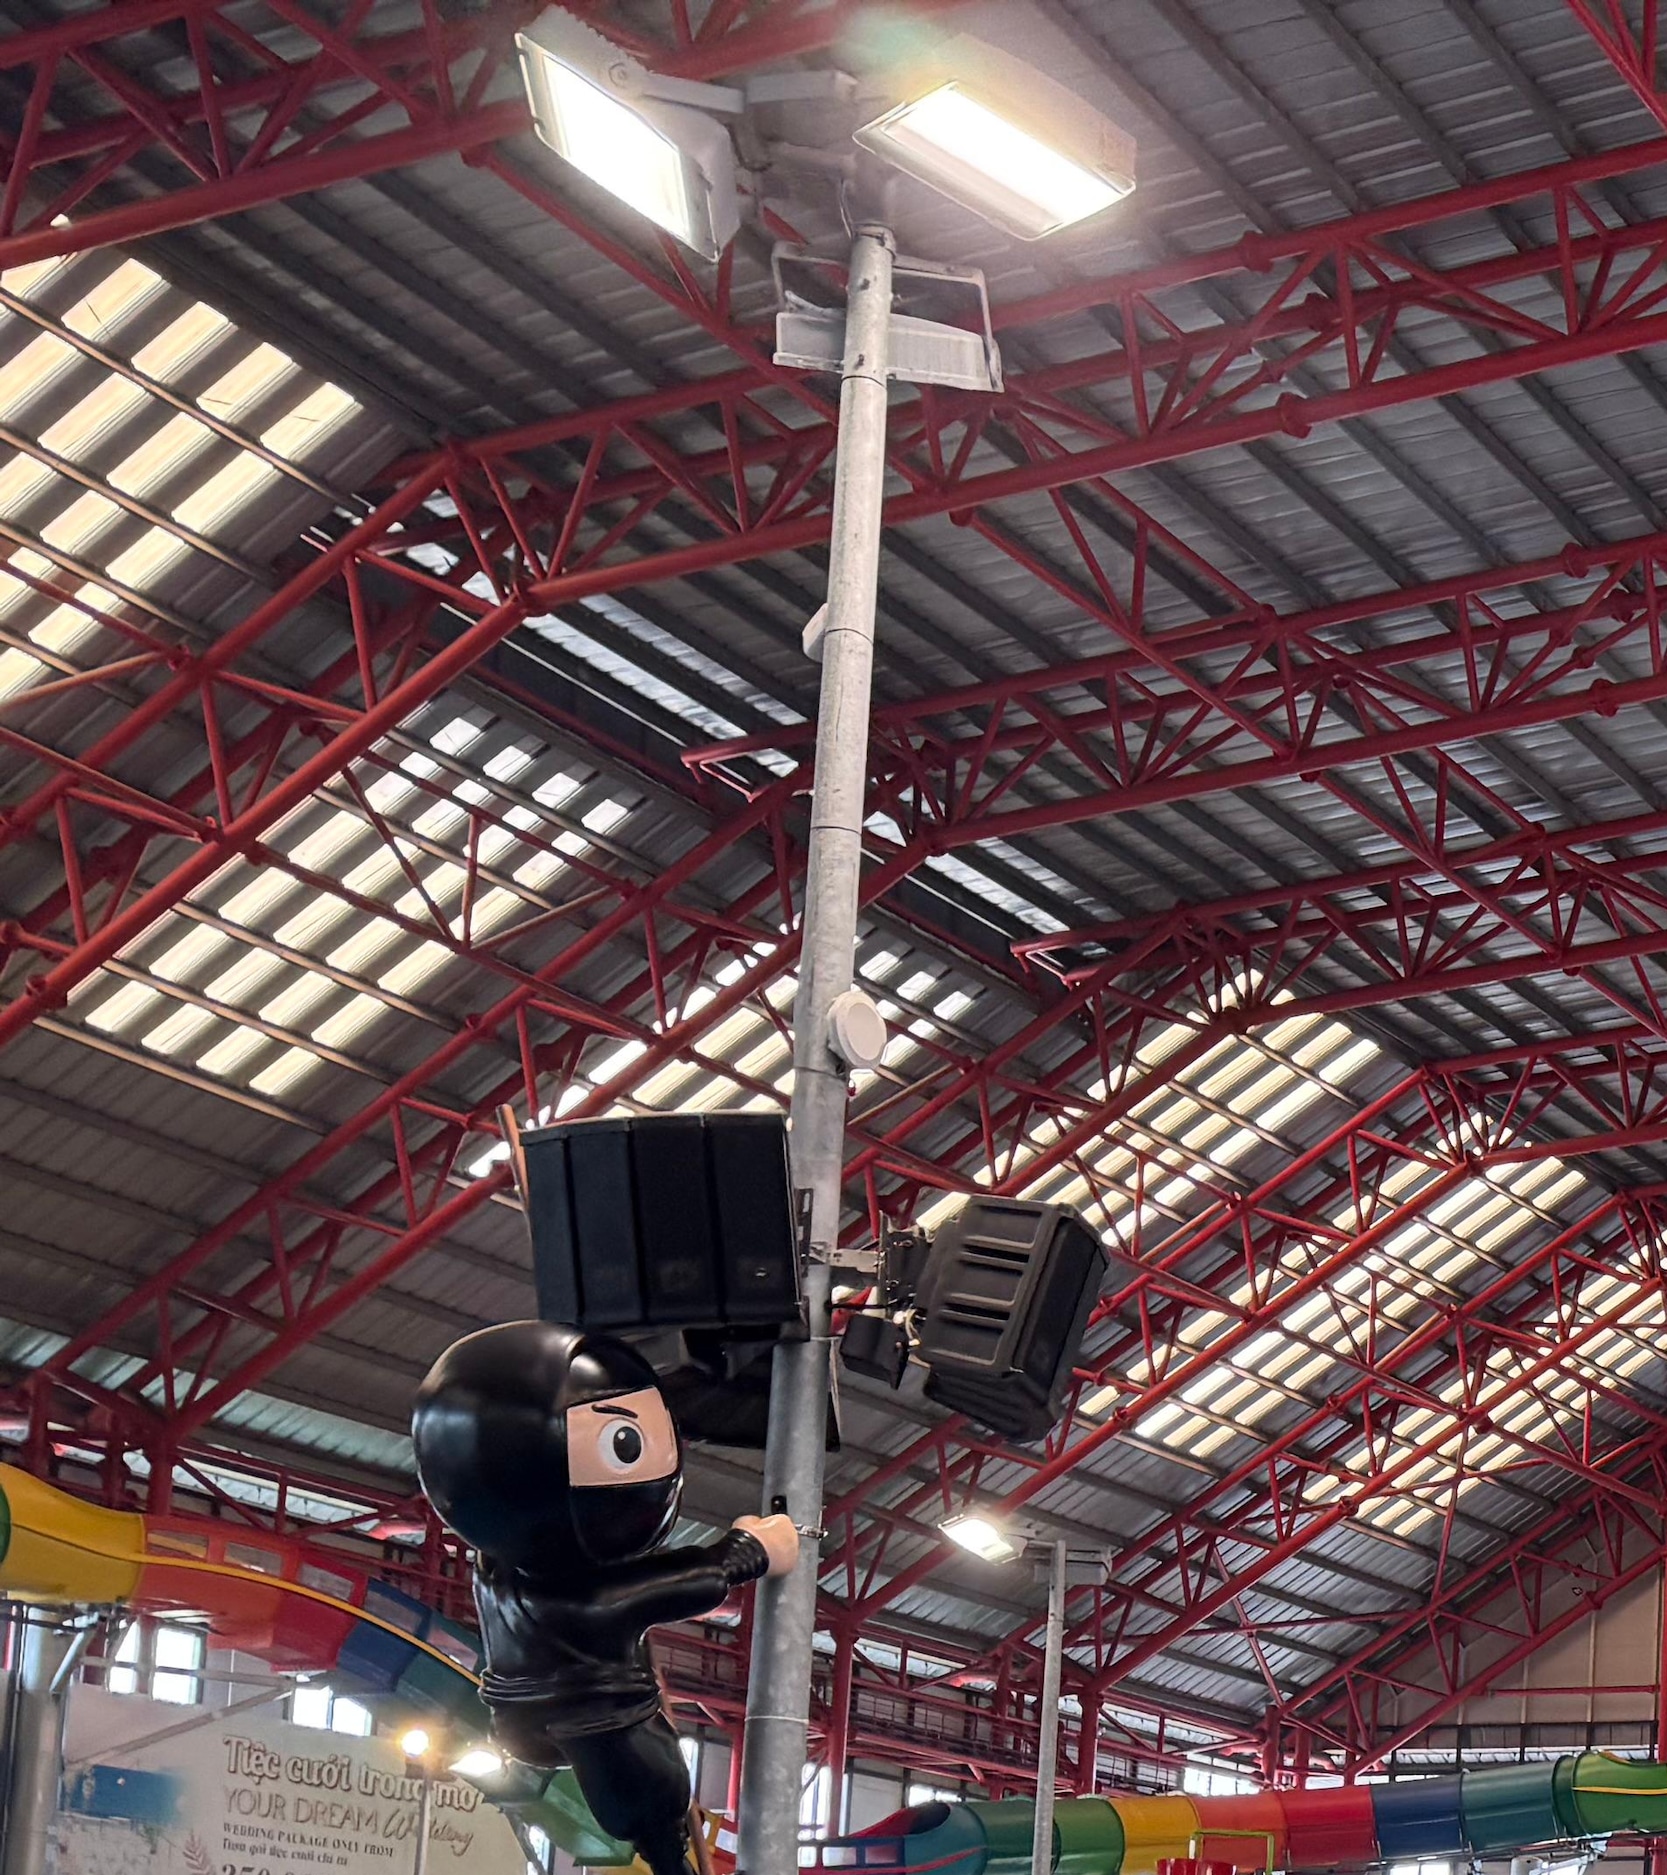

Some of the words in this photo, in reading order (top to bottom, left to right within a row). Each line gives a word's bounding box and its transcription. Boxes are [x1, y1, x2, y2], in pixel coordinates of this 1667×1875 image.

[223, 1735, 280, 1786] Tiệc
[285, 1752, 351, 1791] cưới
[224, 1786, 286, 1821] YOUR
[294, 1798, 378, 1834] DREAM
[223, 1822, 274, 1840] WEDDING
[278, 1830, 329, 1848] PACKAGE
[333, 1838, 359, 1853] ONLY
[364, 1844, 393, 1858] FROM
